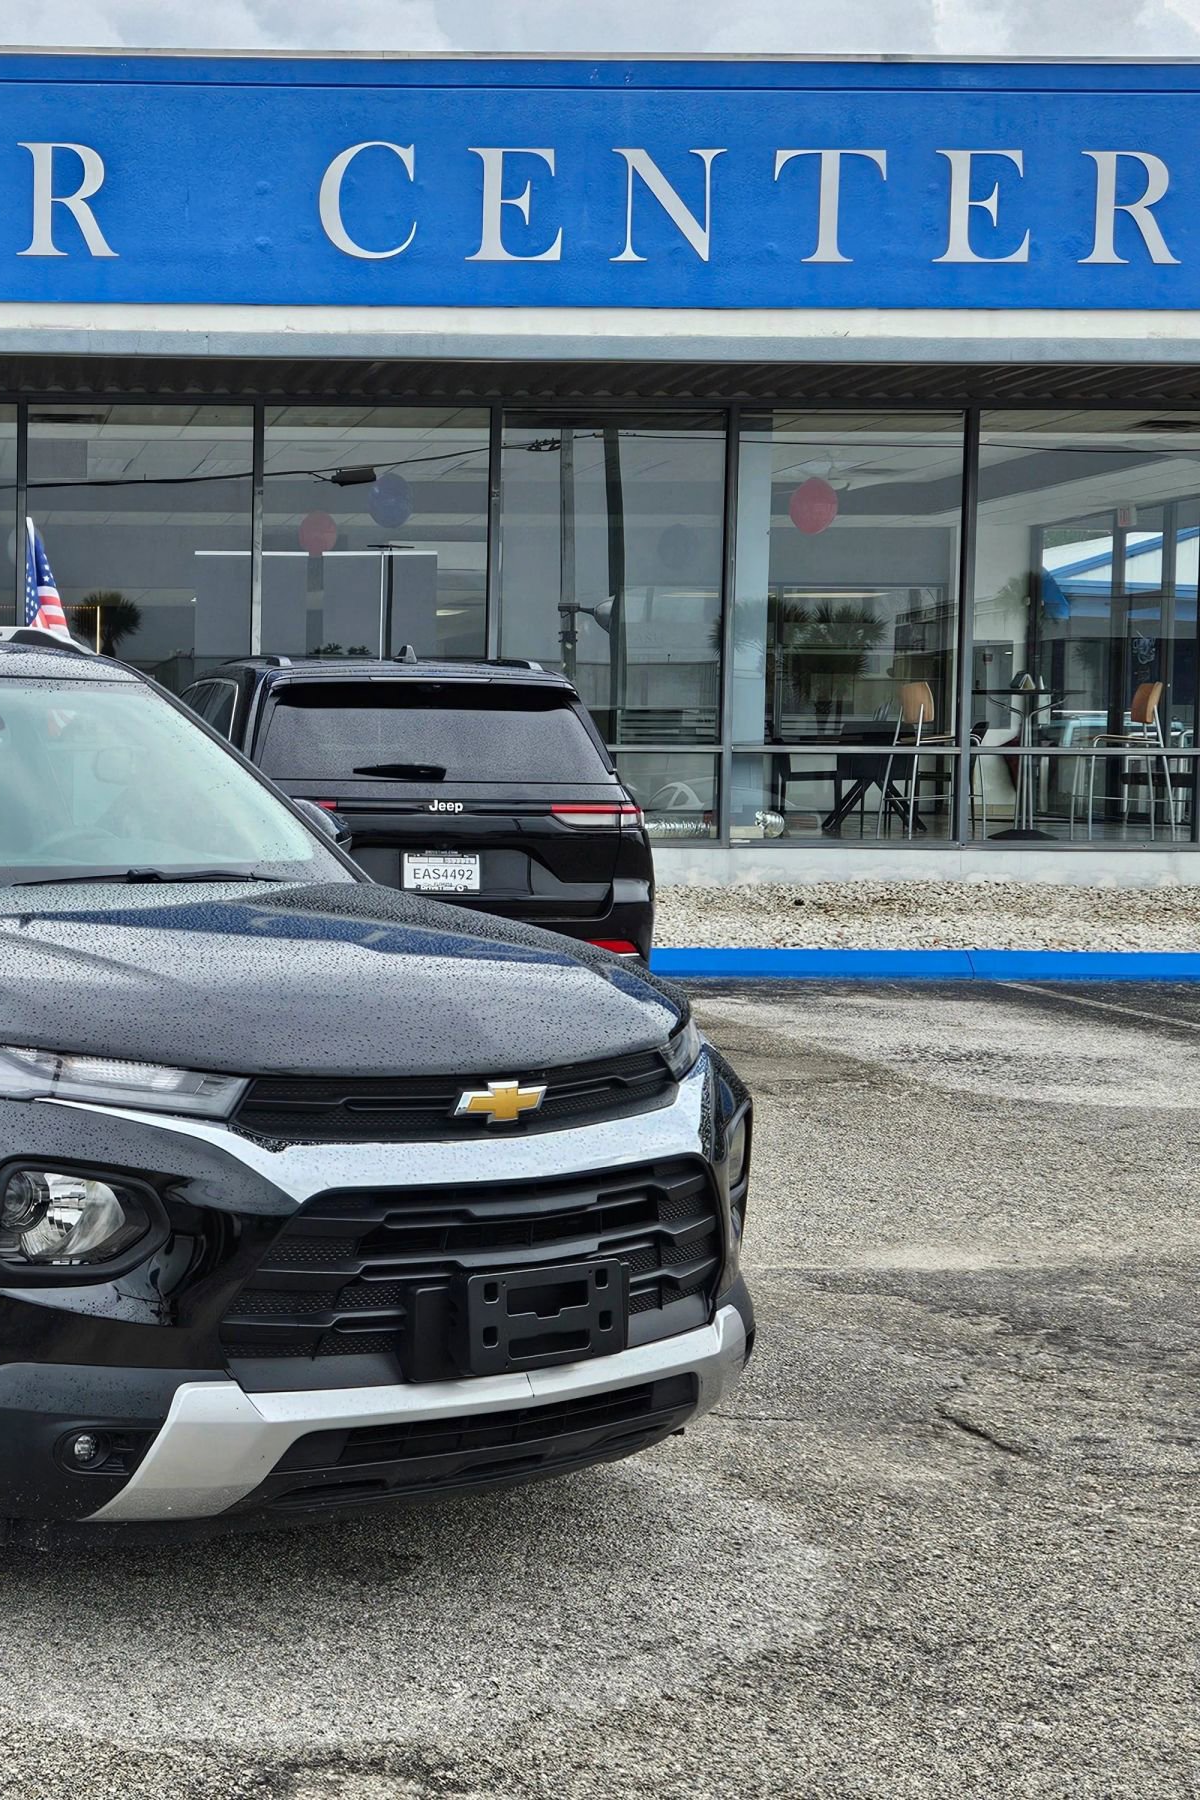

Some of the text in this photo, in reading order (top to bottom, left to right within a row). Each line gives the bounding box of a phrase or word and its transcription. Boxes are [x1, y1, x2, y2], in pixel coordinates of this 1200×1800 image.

[318, 141, 1182, 265] CENTER
[429, 800, 463, 813] Jeep
[413, 868, 473, 880] EAS4492
